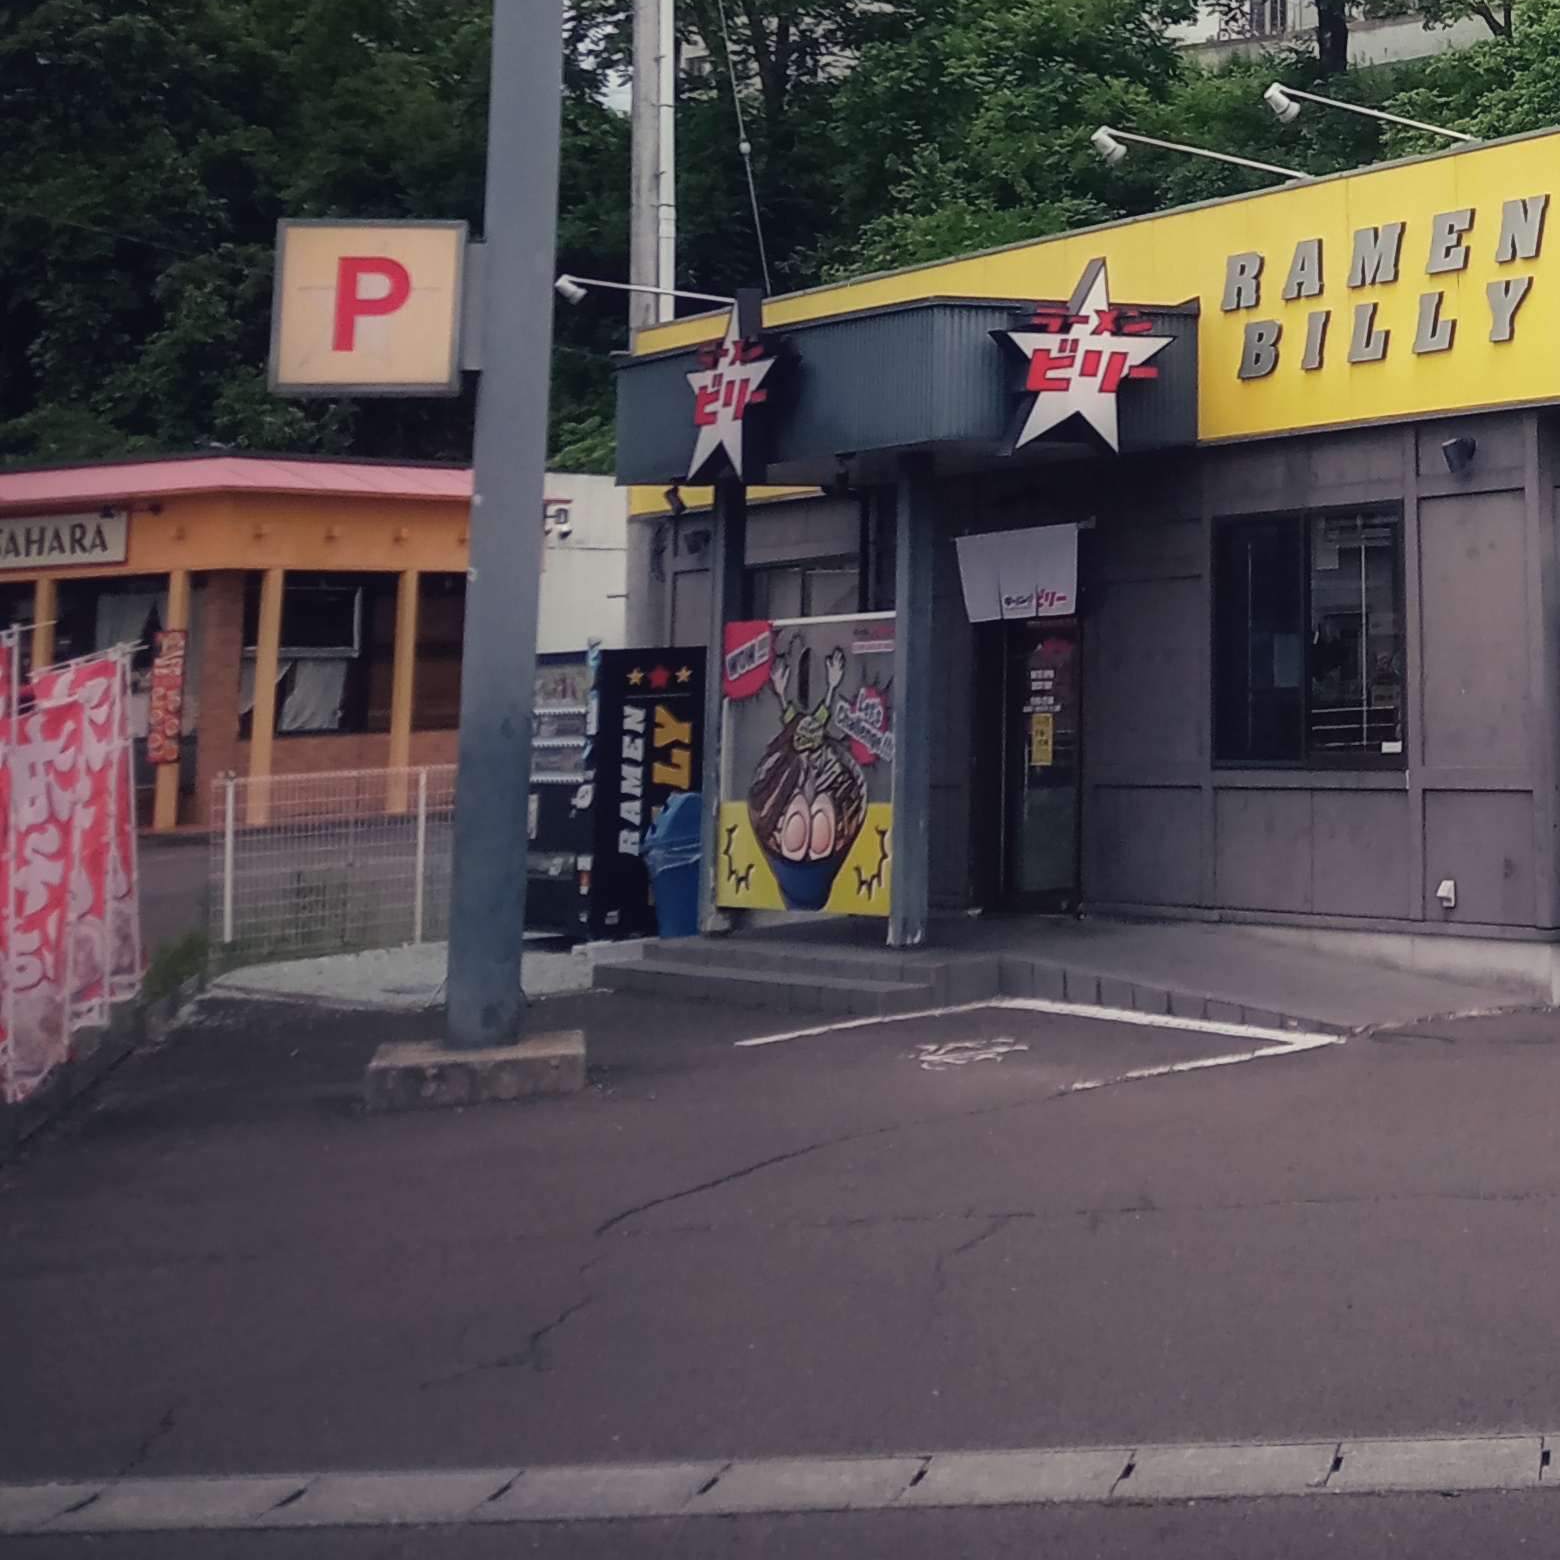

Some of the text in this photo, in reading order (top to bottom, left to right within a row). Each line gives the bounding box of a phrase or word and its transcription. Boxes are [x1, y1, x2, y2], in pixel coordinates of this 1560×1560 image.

[1221, 194, 1551, 312] RAMEN
[331, 255, 411, 352] P
[1032, 306, 1153, 335] ラーメン
[1236, 276, 1534, 380] BILLY
[693, 372, 767, 426] ビリー
[1026, 338, 1159, 393] ビリー
[0, 522, 109, 558] AHARA
[618, 704, 647, 857] RAMEN
